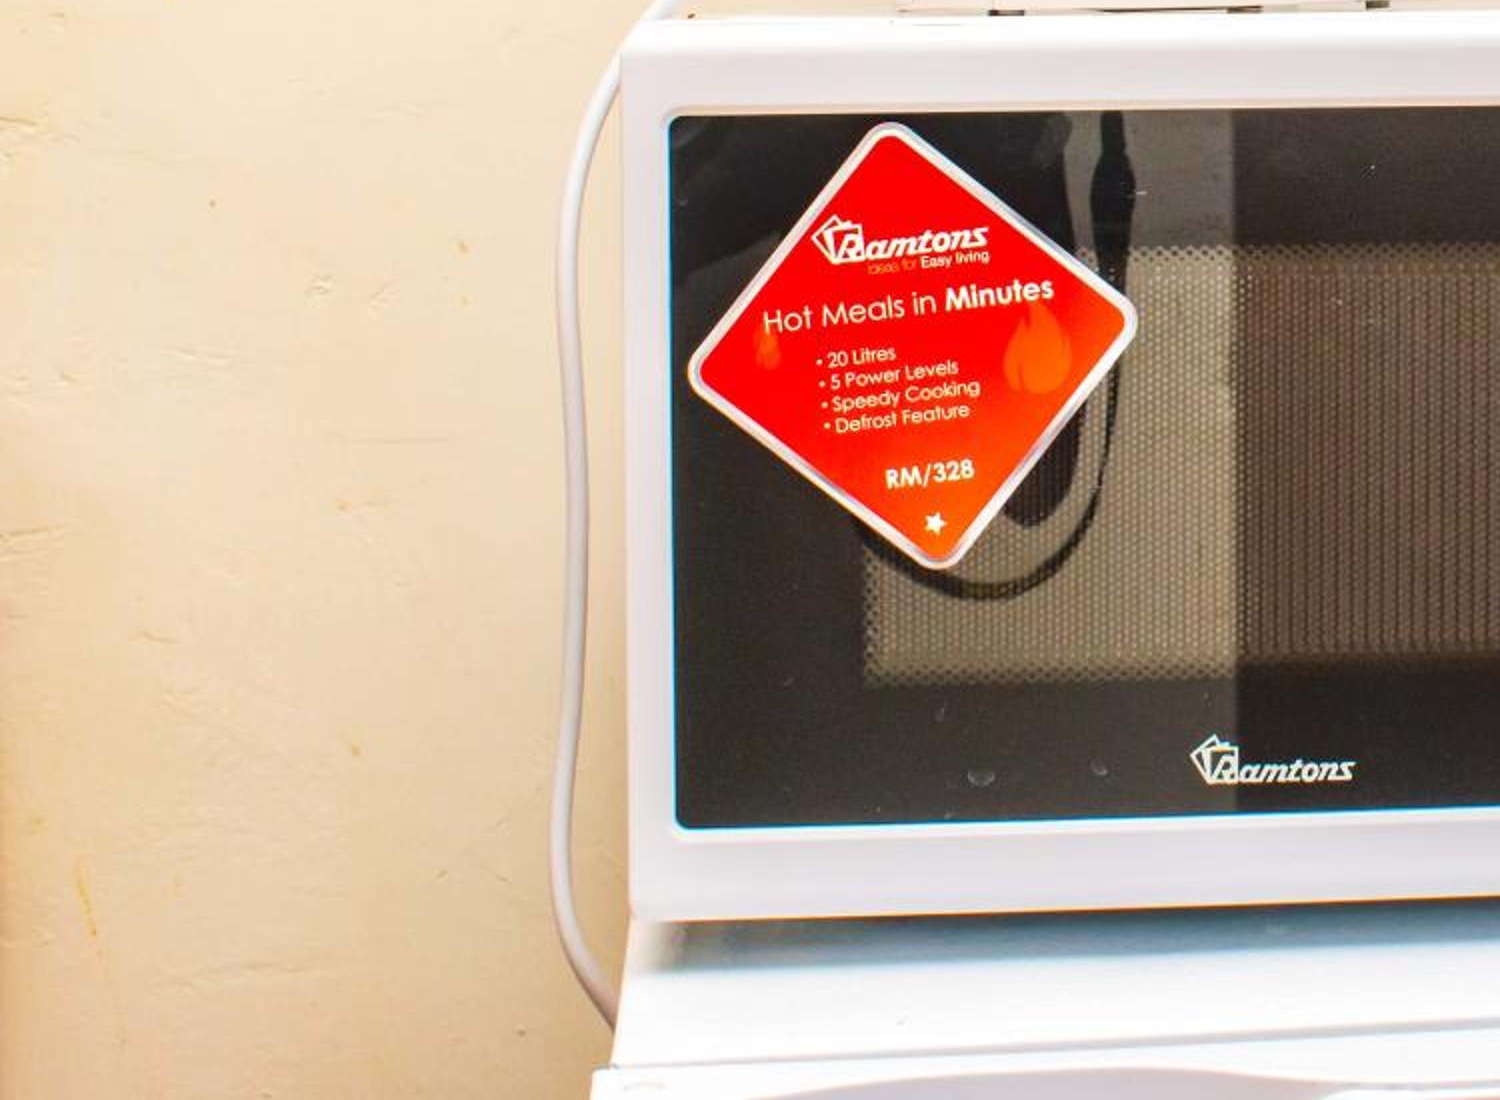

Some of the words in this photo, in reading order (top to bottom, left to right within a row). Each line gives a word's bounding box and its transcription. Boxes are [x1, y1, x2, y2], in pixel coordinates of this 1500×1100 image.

[832, 224, 989, 264] Ramtons
[921, 255, 952, 269] Easy
[955, 250, 990, 265] living
[763, 305, 813, 335] Hot
[822, 294, 905, 328] Meals
[912, 291, 937, 315] in
[945, 278, 1055, 311] Minutes
[827, 351, 849, 368] 20
[852, 346, 897, 366] Litres
[830, 375, 841, 390] 5
[845, 369, 900, 388] Power
[905, 359, 959, 381] Levels
[832, 390, 900, 414] Speedy
[905, 379, 981, 403] Cooking
[835, 411, 897, 434] Defrost
[902, 403, 971, 425] Feature
[885, 458, 975, 490] RM/328
[1203, 748, 1357, 785] Ramtons
